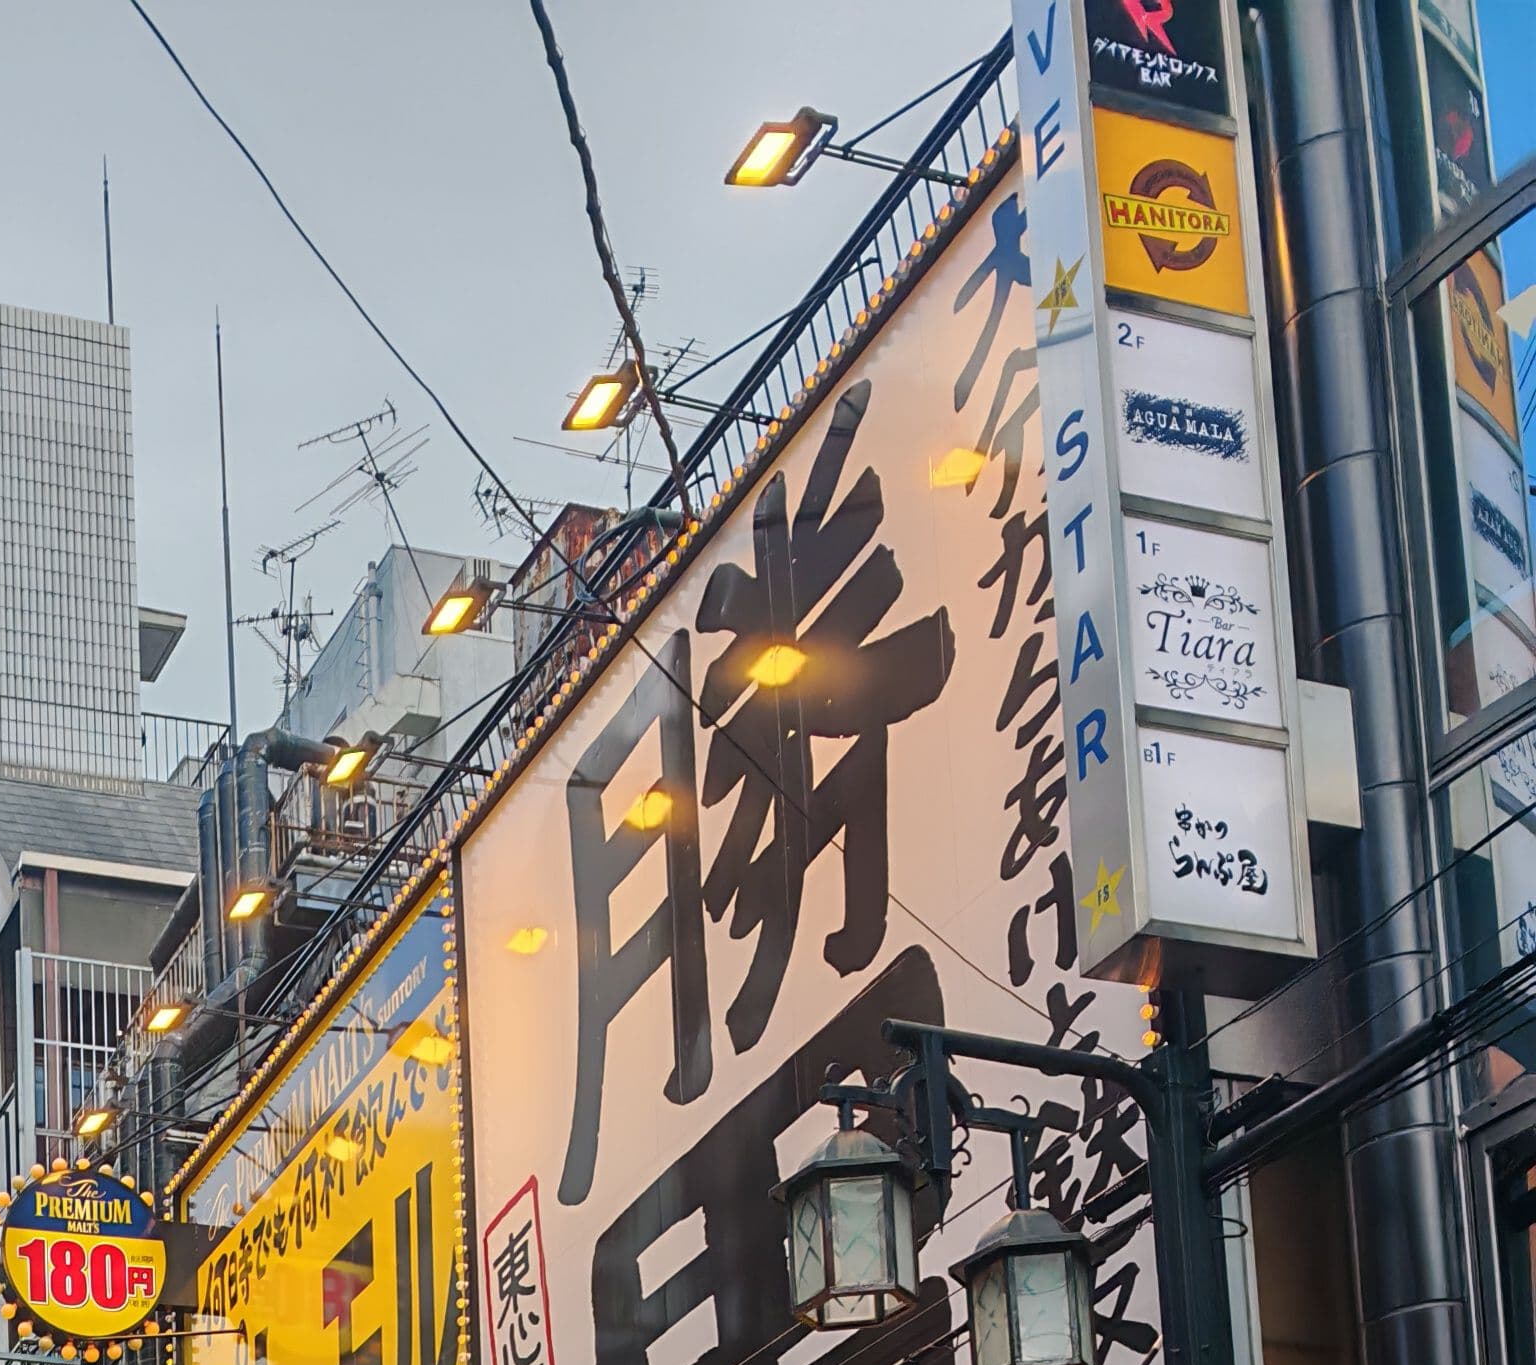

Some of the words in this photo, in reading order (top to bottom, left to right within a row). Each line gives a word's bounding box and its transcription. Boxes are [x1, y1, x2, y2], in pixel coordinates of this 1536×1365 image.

[1141, 69, 1171, 87] BAR
[1110, 200, 1225, 231] HANITORA
[1118, 323, 1144, 349] 2F
[1133, 408, 1180, 431] AGUA
[1185, 418, 1234, 441] MALA
[1136, 531, 1161, 556] 1F
[1055, 408, 1109, 782] STAR
[1147, 610, 1257, 667] Tiara
[1211, 616, 1235, 632] Bar
[1143, 742, 1176, 766] B1F
[1174, 803, 1228, 840] 串かつ
[1169, 836, 1268, 895] らんぷ屋
[235, 1088, 308, 1206] PREMIUM
[35, 1191, 132, 1225] PREMIUM
[67, 1219, 100, 1234] MALT'S
[17, 1237, 156, 1312] 180円
